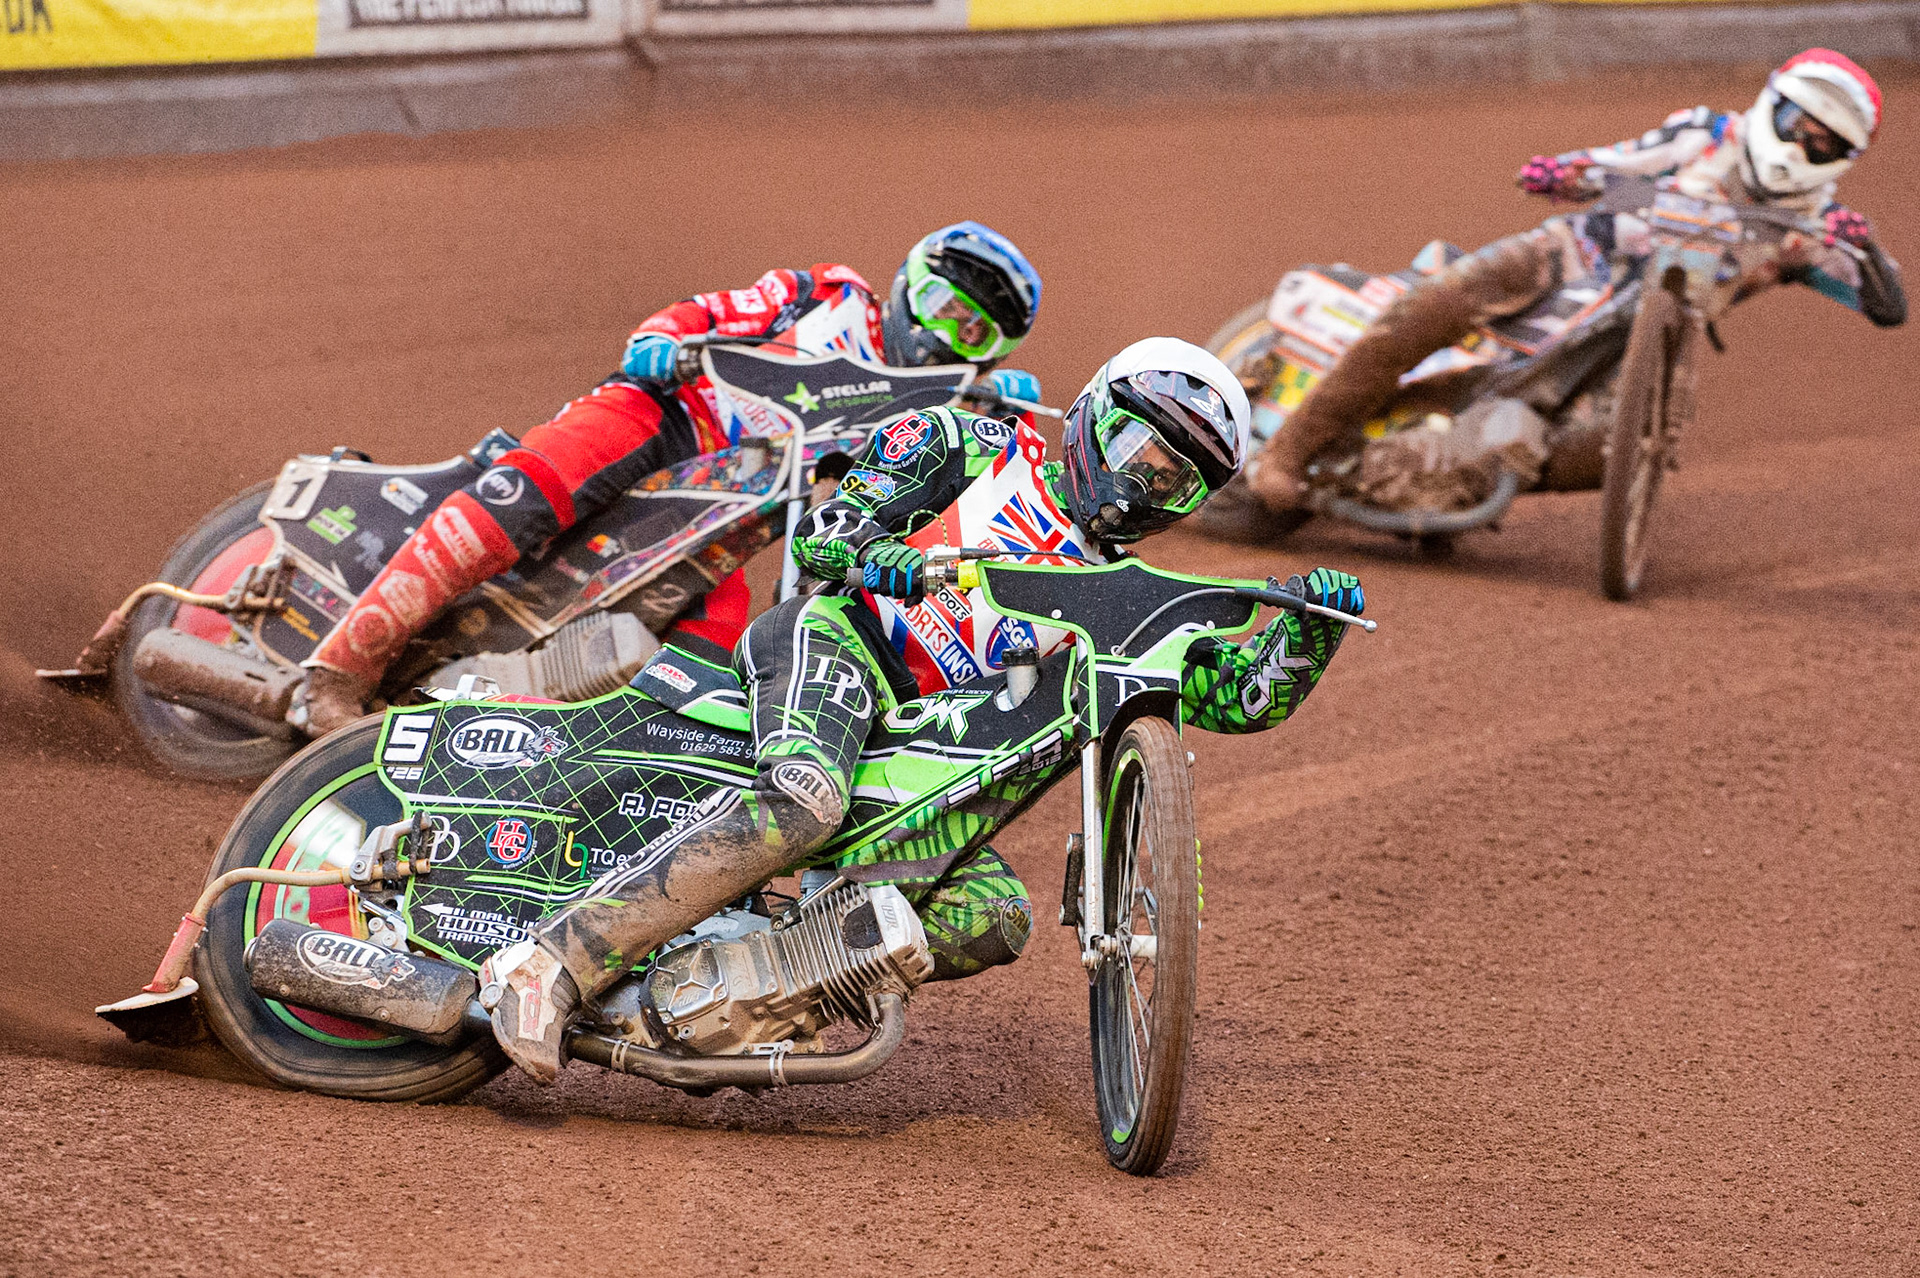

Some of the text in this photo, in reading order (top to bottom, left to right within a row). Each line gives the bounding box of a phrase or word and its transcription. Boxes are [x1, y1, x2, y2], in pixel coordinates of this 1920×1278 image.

[821, 380, 892, 399] STELLAR
[283, 477, 315, 508] 1
[383, 714, 436, 762] 5
[461, 727, 530, 753] BALL
[646, 722, 745, 748] Wayside Farm
[680, 741, 716, 753] 01629
[720, 744, 742, 757] 582
[385, 765, 424, 780] #26
[590, 847, 616, 867] TQ
